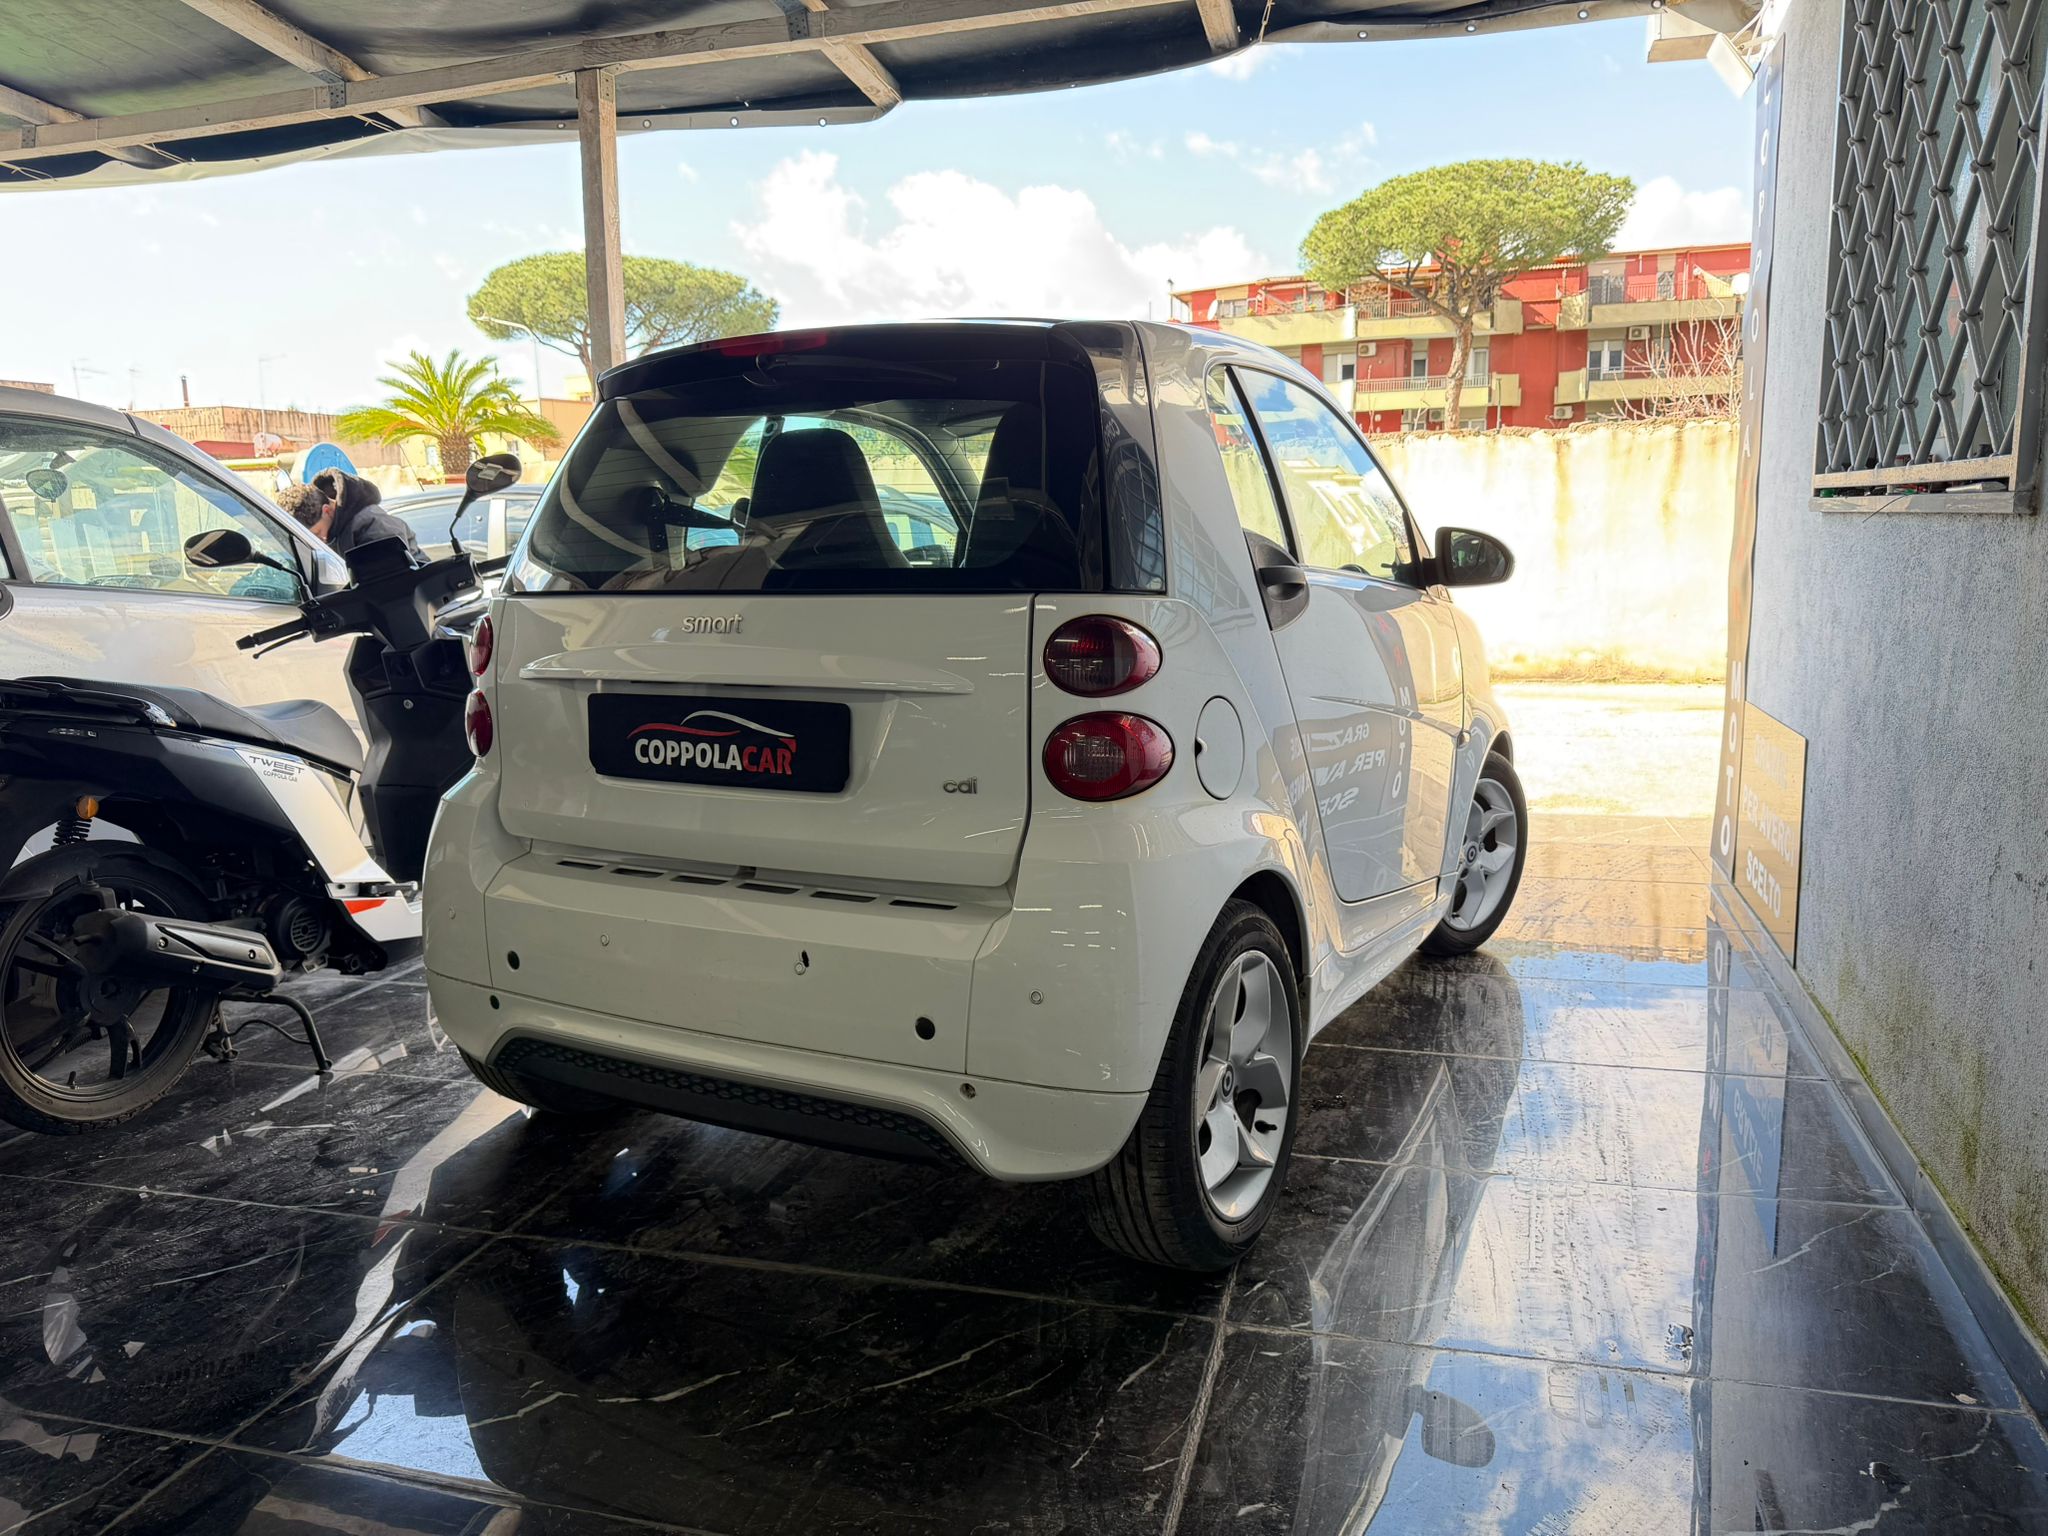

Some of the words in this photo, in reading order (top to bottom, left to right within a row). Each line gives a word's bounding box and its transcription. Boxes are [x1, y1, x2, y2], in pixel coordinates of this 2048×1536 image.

[681, 614, 743, 634] smart
[249, 755, 305, 774] TWEET
[634, 738, 793, 775] COPPOLACAR
[1720, 660, 1742, 857] MOTO
[943, 776, 978, 795] cdi
[1746, 850, 1782, 918] SCELTO
